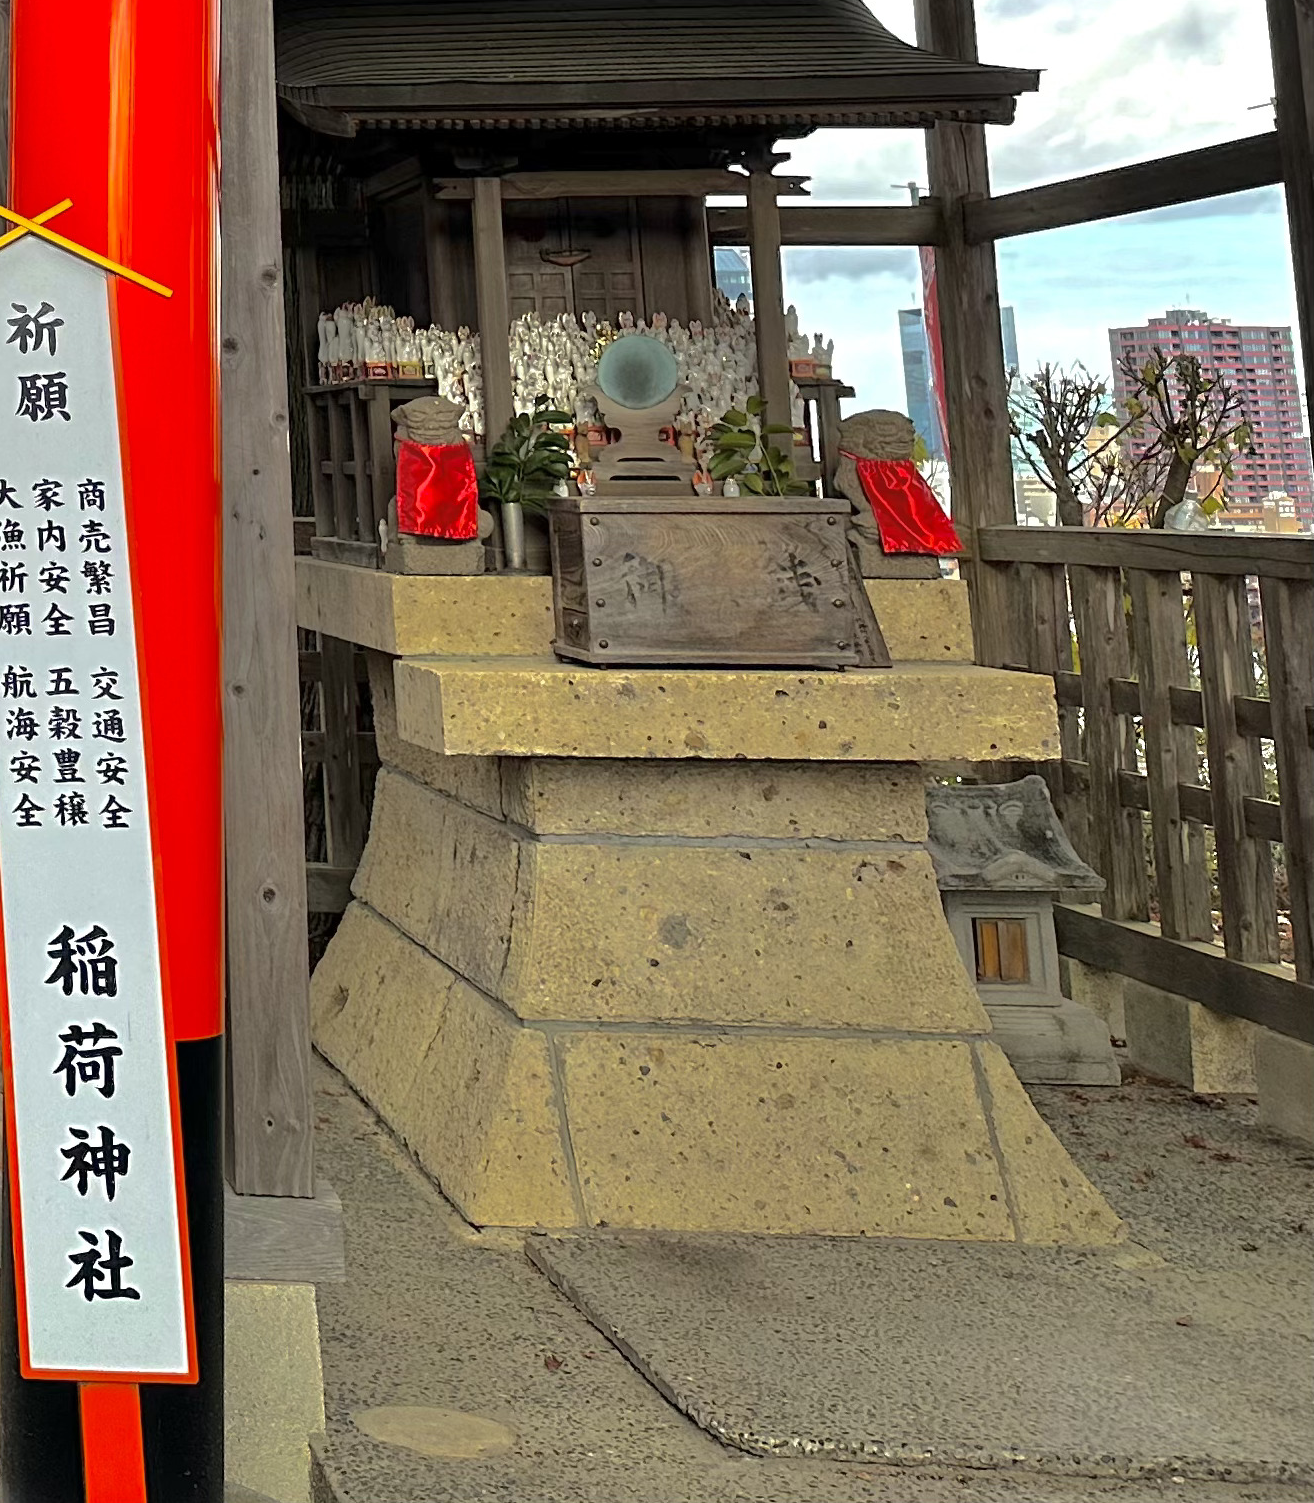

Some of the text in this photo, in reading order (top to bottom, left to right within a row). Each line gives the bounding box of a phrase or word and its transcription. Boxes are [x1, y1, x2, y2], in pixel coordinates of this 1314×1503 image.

[5, 301, 73, 423] 祈願
[1, 664, 46, 828] 航海安全
[31, 477, 90, 828] 家内安全 五穀豊穣
[77, 477, 133, 829] 商売繁昌 交通安全
[44, 924, 142, 1303] 稲荷神社
